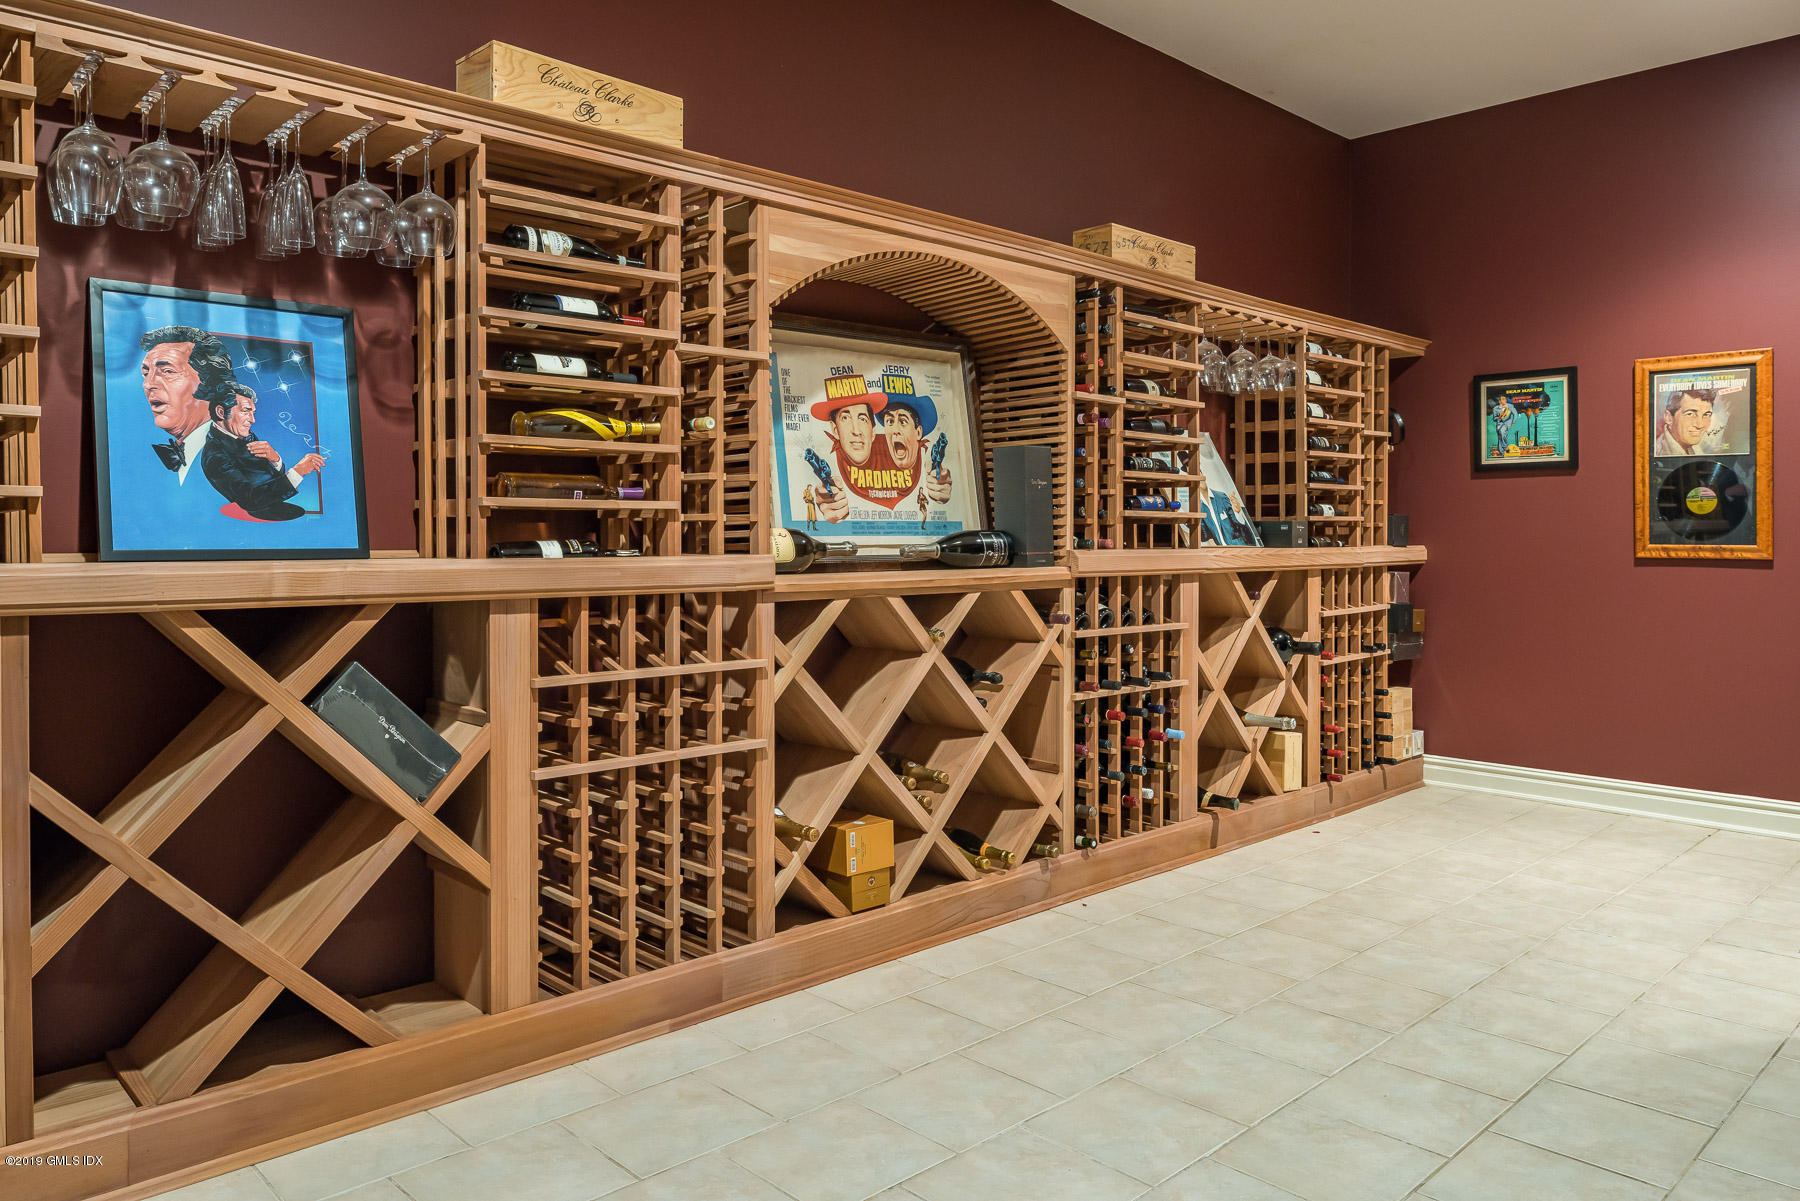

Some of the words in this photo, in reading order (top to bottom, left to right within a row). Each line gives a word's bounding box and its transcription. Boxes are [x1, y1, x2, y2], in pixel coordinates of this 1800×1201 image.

[592, 79, 635, 108] Clarke
[781, 368, 791, 378] ONE
[830, 365, 854, 376] DEAN
[882, 364, 910, 375] JERRY
[782, 377, 788, 386] OF
[1659, 383, 1692, 392] EVERYBODY
[1694, 381, 1712, 390] LOVES
[1714, 378, 1747, 388] SOMEBODY
[783, 386, 791, 394] THE
[827, 377, 867, 398] MARTIN
[866, 378, 882, 389] and
[884, 376, 914, 395] LEWIS
[785, 404, 798, 413] FILMS
[785, 413, 796, 422] THEY
[798, 414, 810, 422] EVER
[786, 422, 801, 432] MADE!
[868, 489, 898, 499] TECHNICOLOR
